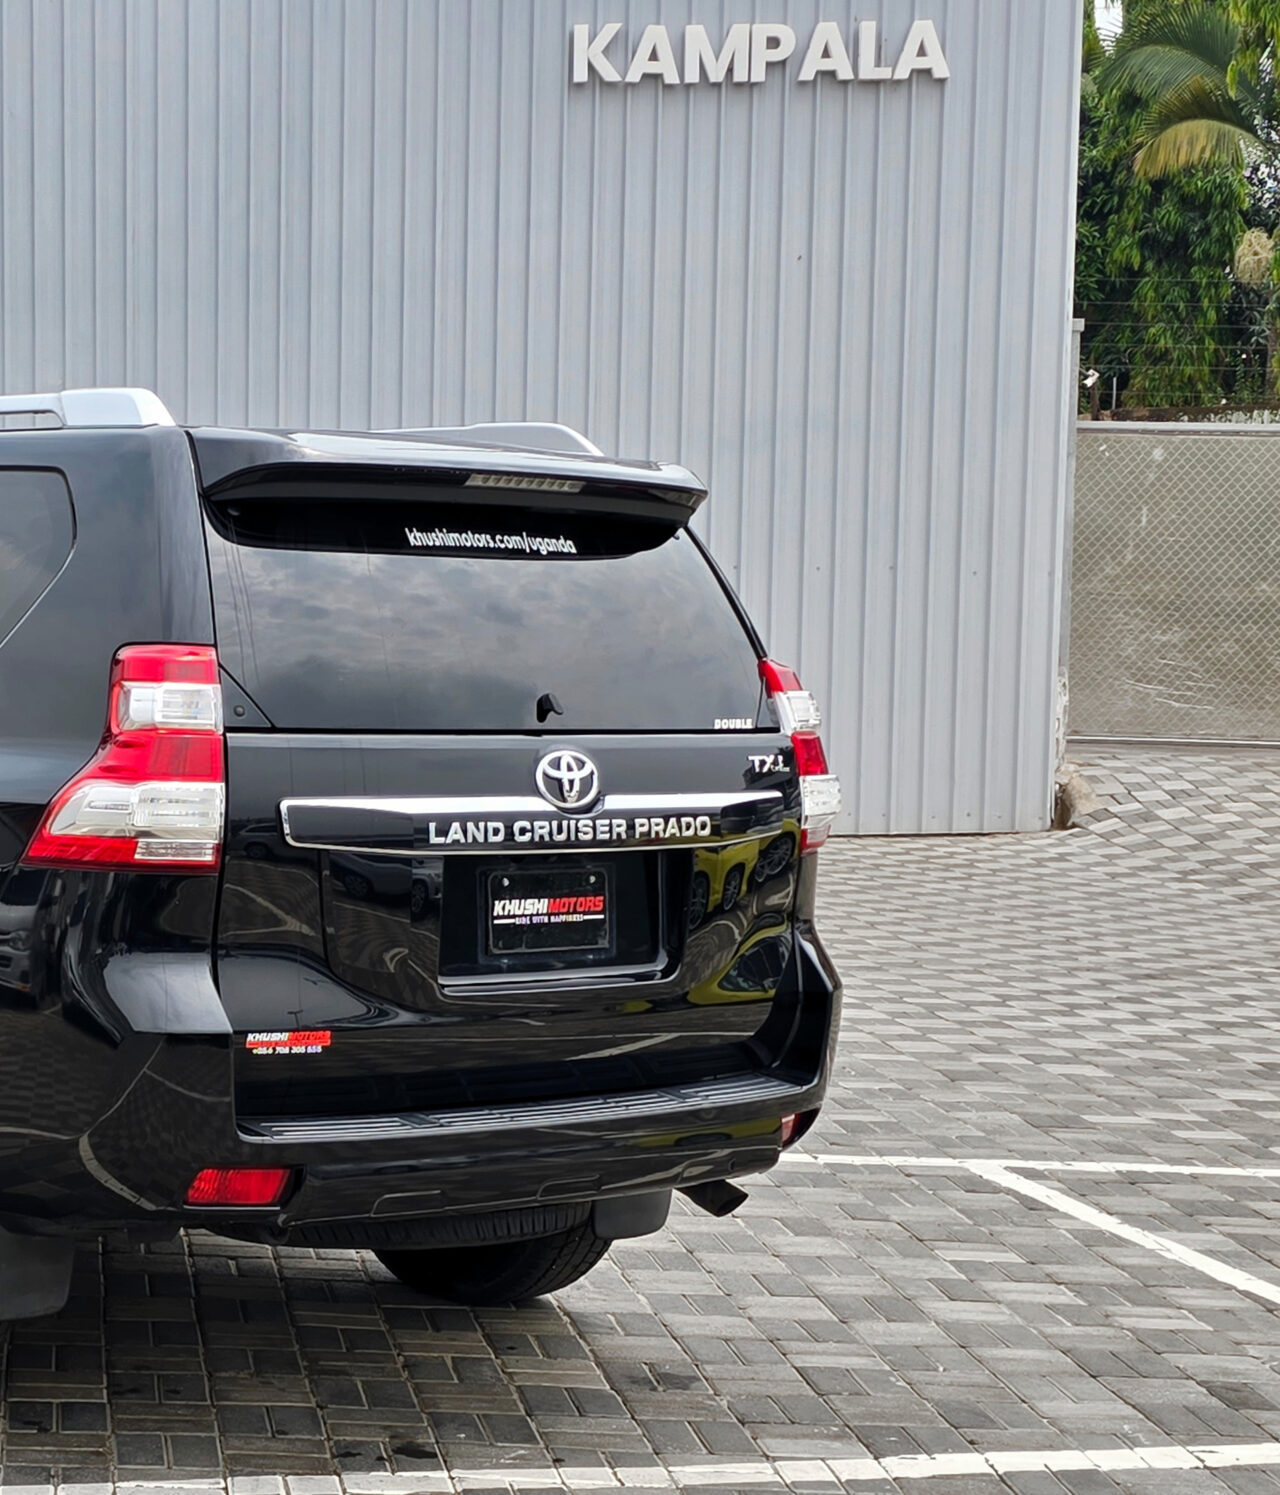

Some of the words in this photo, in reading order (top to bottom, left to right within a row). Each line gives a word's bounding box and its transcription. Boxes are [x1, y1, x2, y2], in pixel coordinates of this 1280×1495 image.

[572, 19, 951, 85] KAMPALA
[405, 527, 577, 555] khushimotors.com/uganda
[714, 718, 753, 729] DOUBLE
[428, 820, 505, 844] LAND
[513, 818, 627, 843] CRUISER
[634, 816, 711, 839] PRADO
